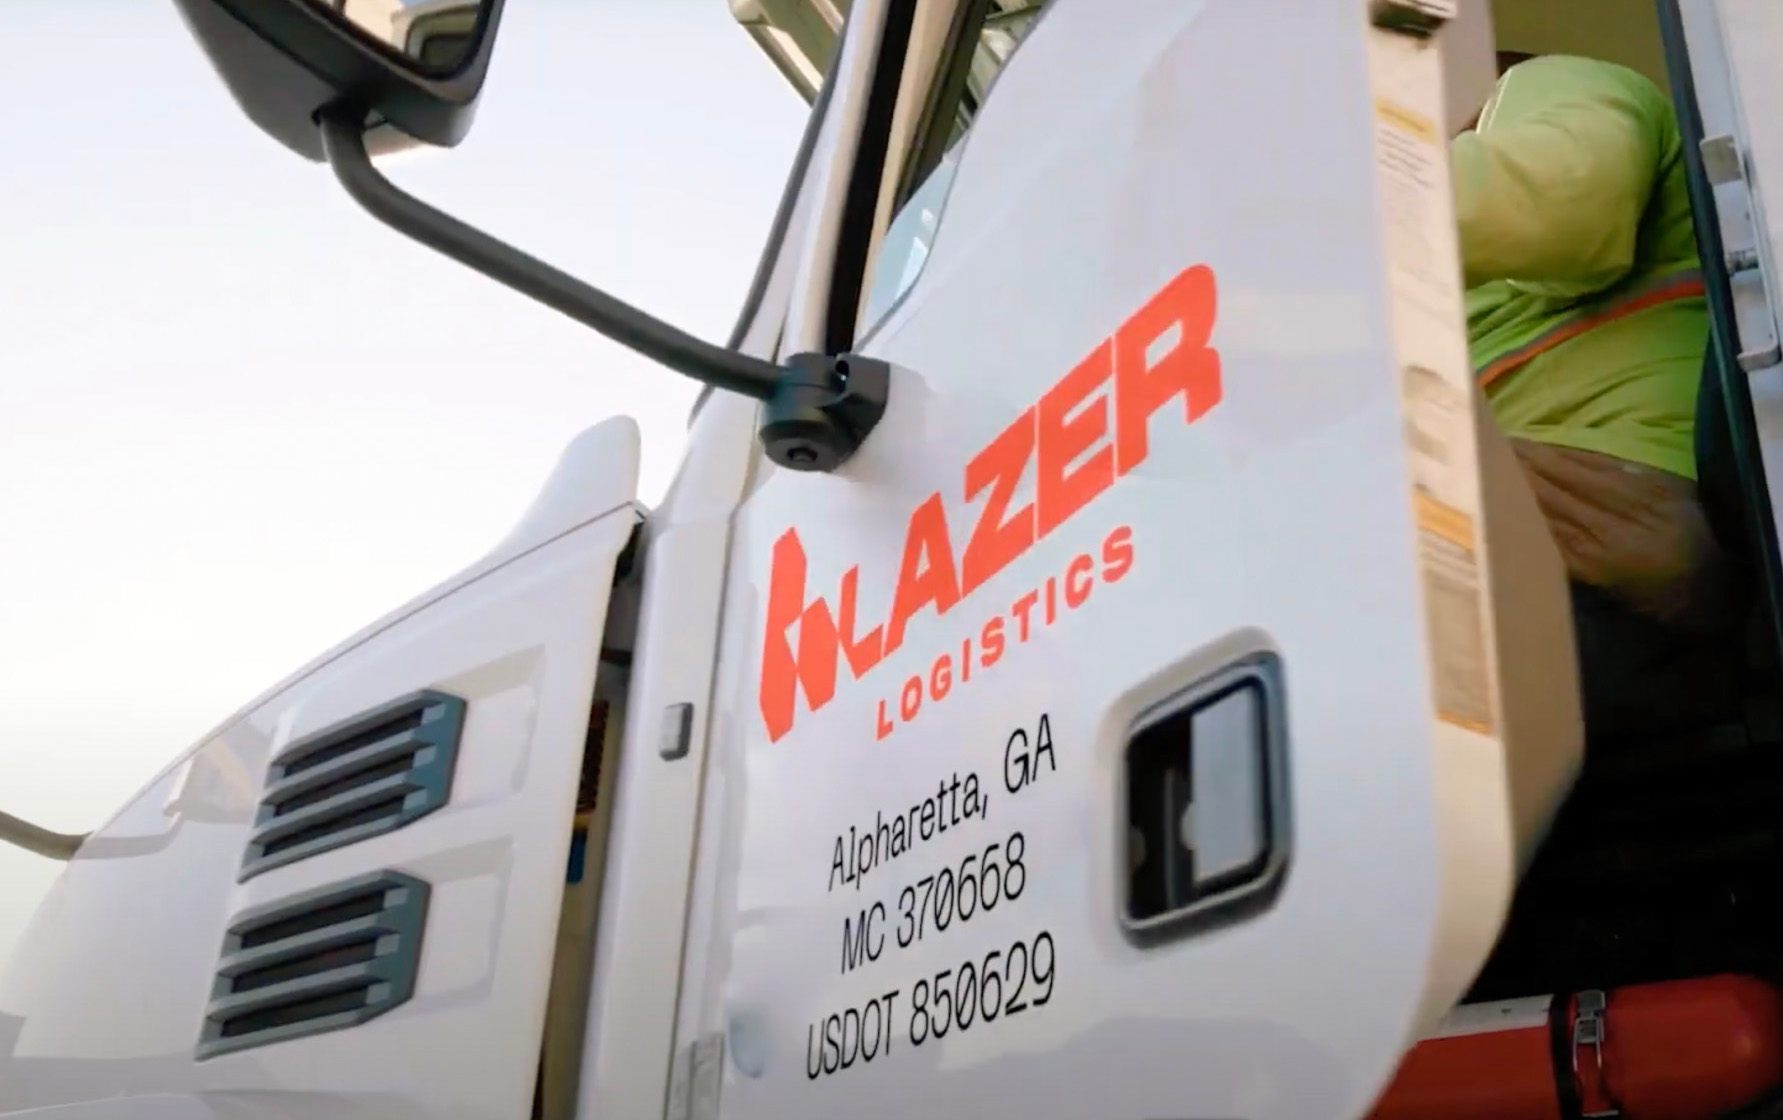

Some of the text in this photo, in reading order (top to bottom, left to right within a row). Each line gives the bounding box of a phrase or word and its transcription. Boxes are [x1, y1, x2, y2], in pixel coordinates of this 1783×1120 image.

[838, 263, 1223, 680] LAZER
[876, 525, 1136, 742] LOGISTICS
[828, 712, 1057, 892] Alpharetta, GA
[840, 832, 1027, 975] MC 370668
[806, 931, 1056, 1081] USDOT 850629
